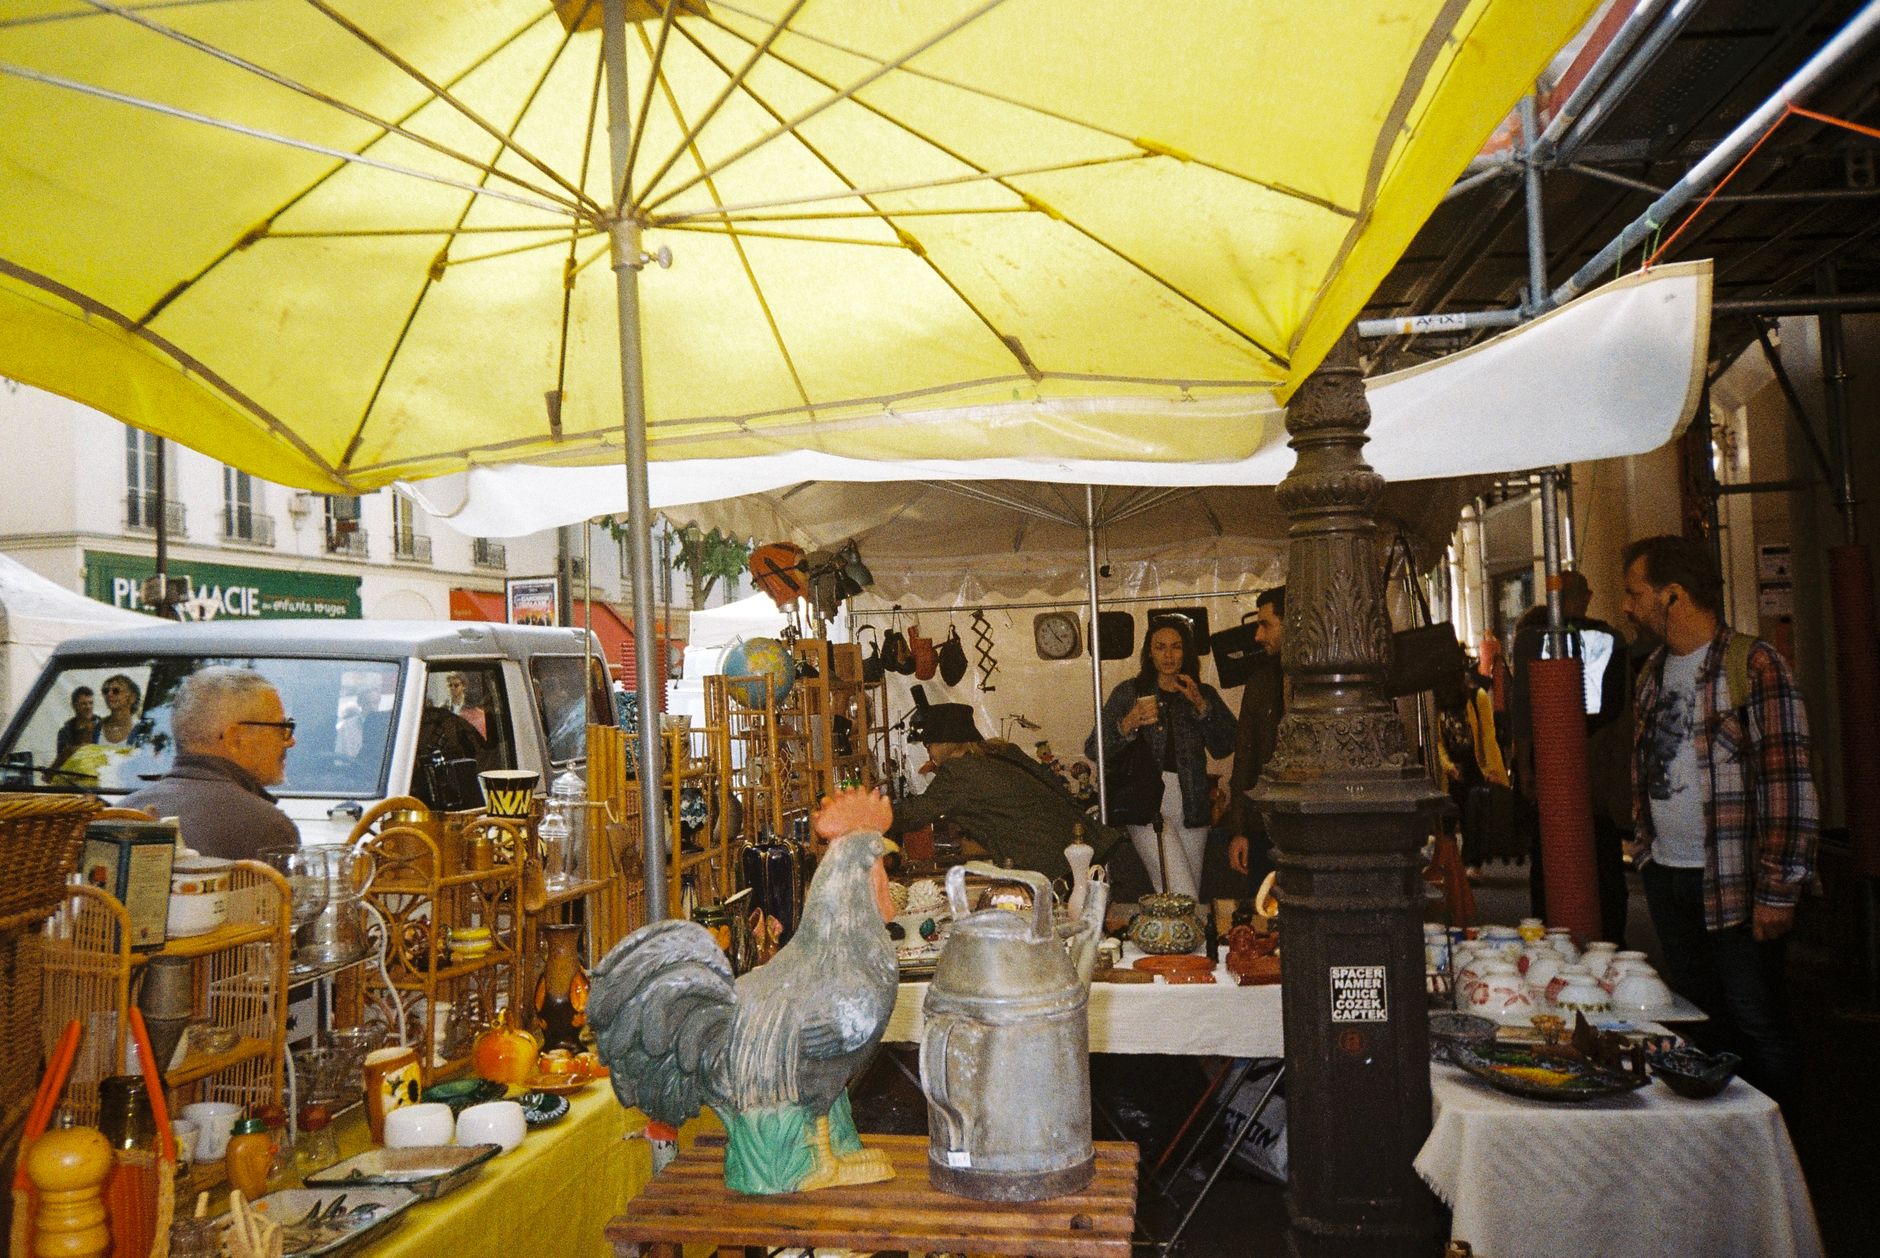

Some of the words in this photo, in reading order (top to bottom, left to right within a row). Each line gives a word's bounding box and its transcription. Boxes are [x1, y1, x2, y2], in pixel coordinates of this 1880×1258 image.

[114, 577, 260, 621] PHMACIE
[273, 599, 312, 613] enfants
[314, 602, 347, 617] rouges
[1332, 968, 1383, 979] SPACER
[1334, 978, 1381, 989] NAMER
[1339, 989, 1378, 999] JUICE
[1336, 999, 1381, 1009] COZEK
[1333, 1009, 1386, 1019] CAPTEK
